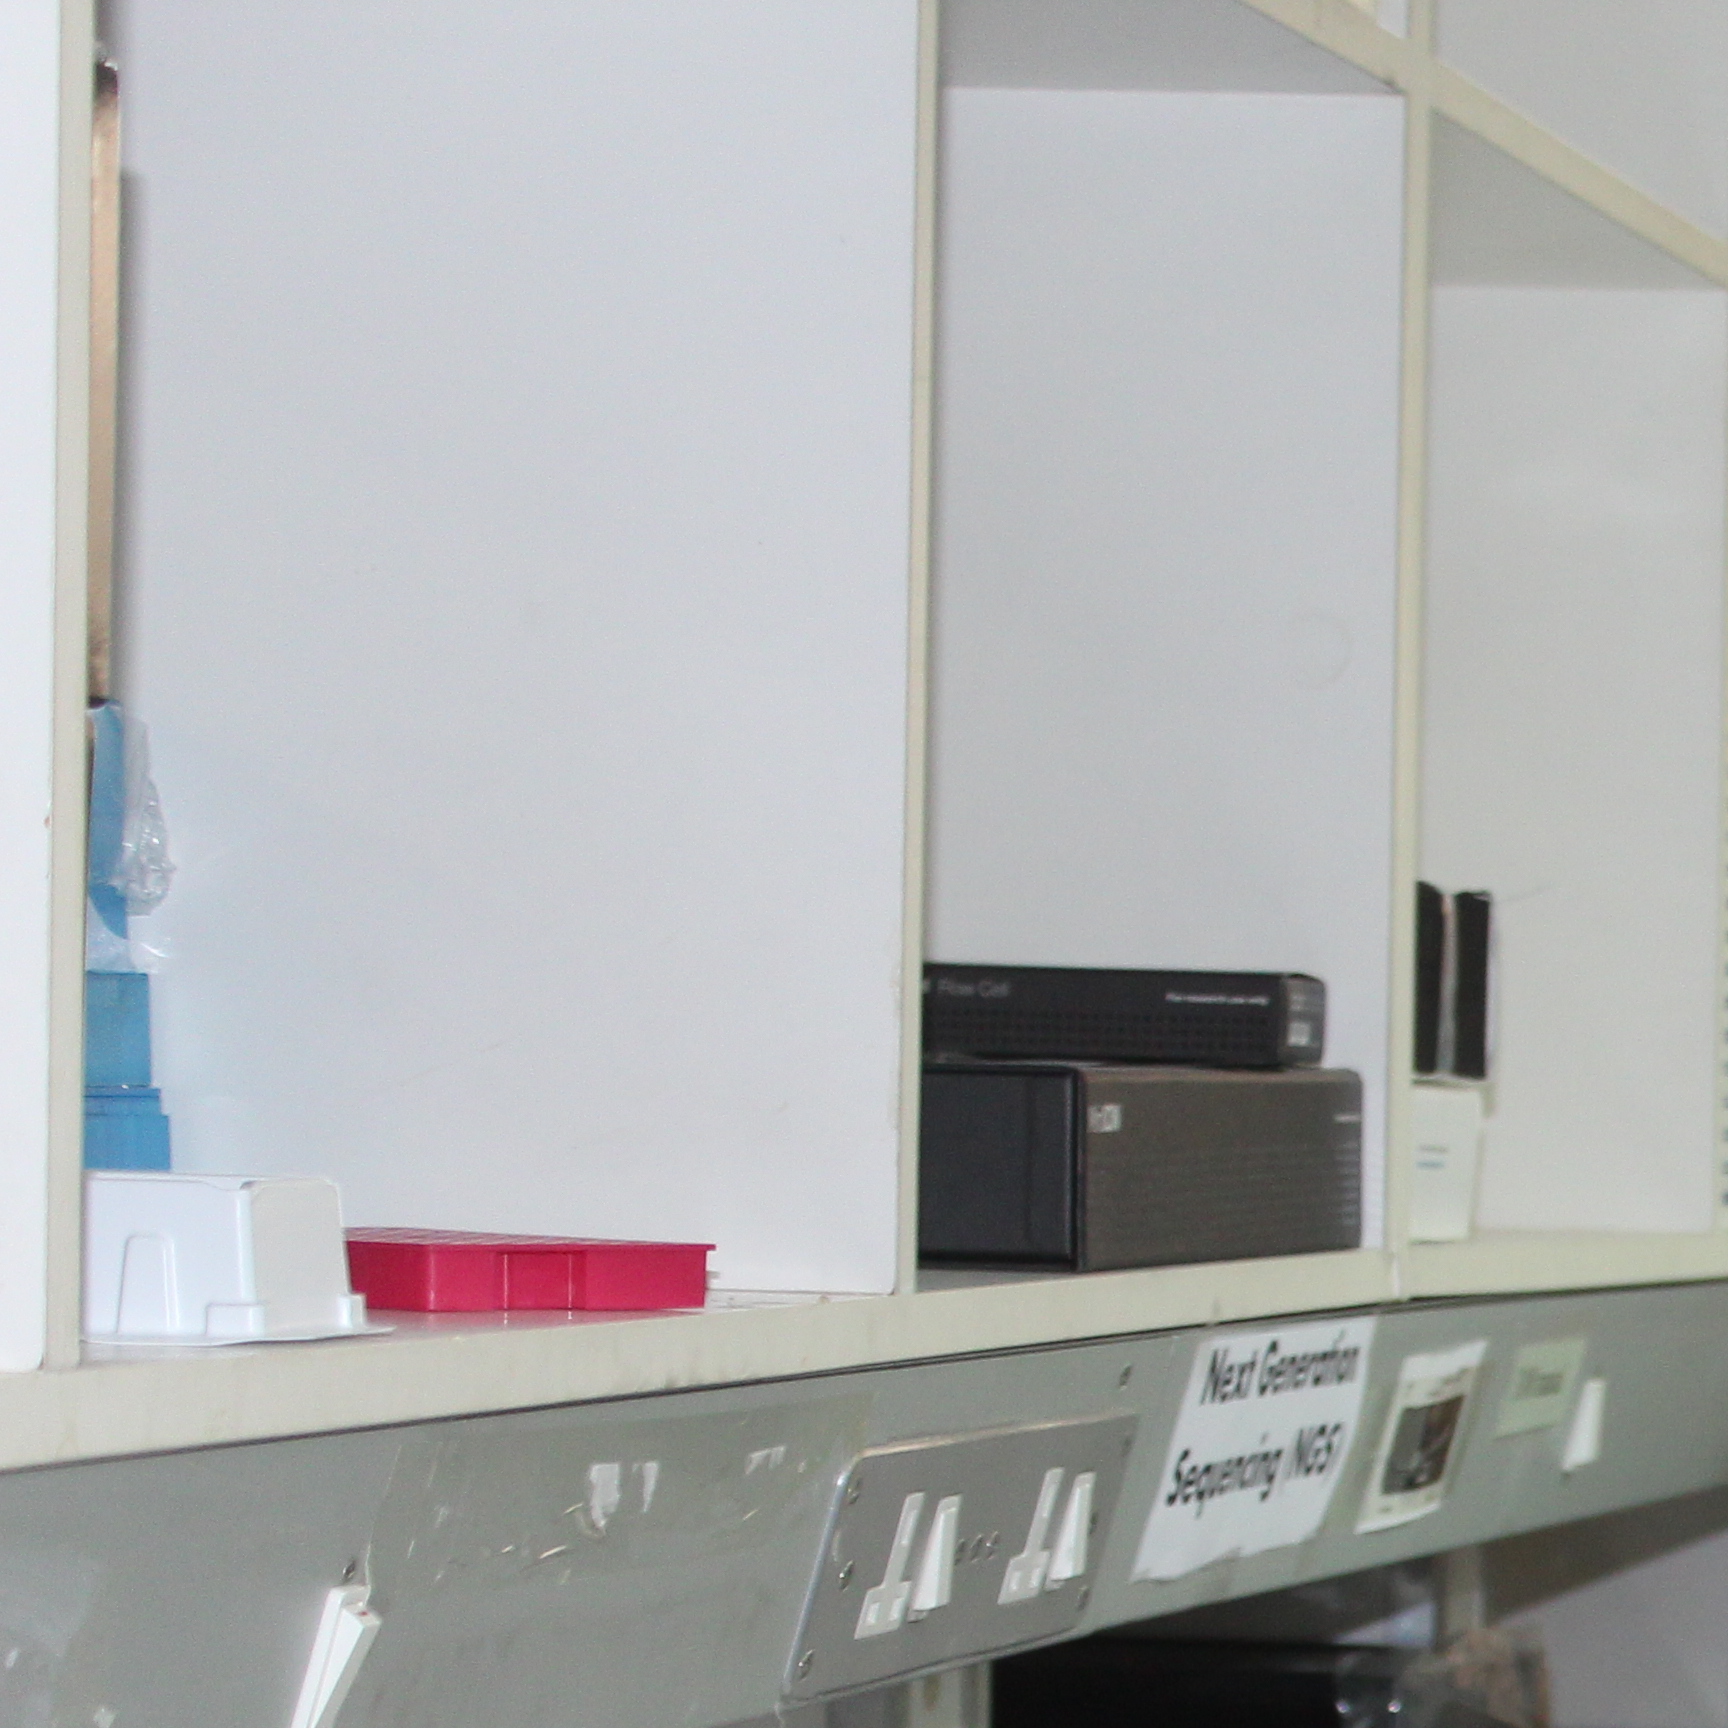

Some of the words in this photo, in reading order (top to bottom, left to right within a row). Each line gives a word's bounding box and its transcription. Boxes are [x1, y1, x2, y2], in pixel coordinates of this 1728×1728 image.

[1201, 1350, 1257, 1404] Next
[1259, 1329, 1360, 1395] Generation
[1166, 1433, 1283, 1518] Sequencing
[1285, 1423, 1343, 1479] NGS
